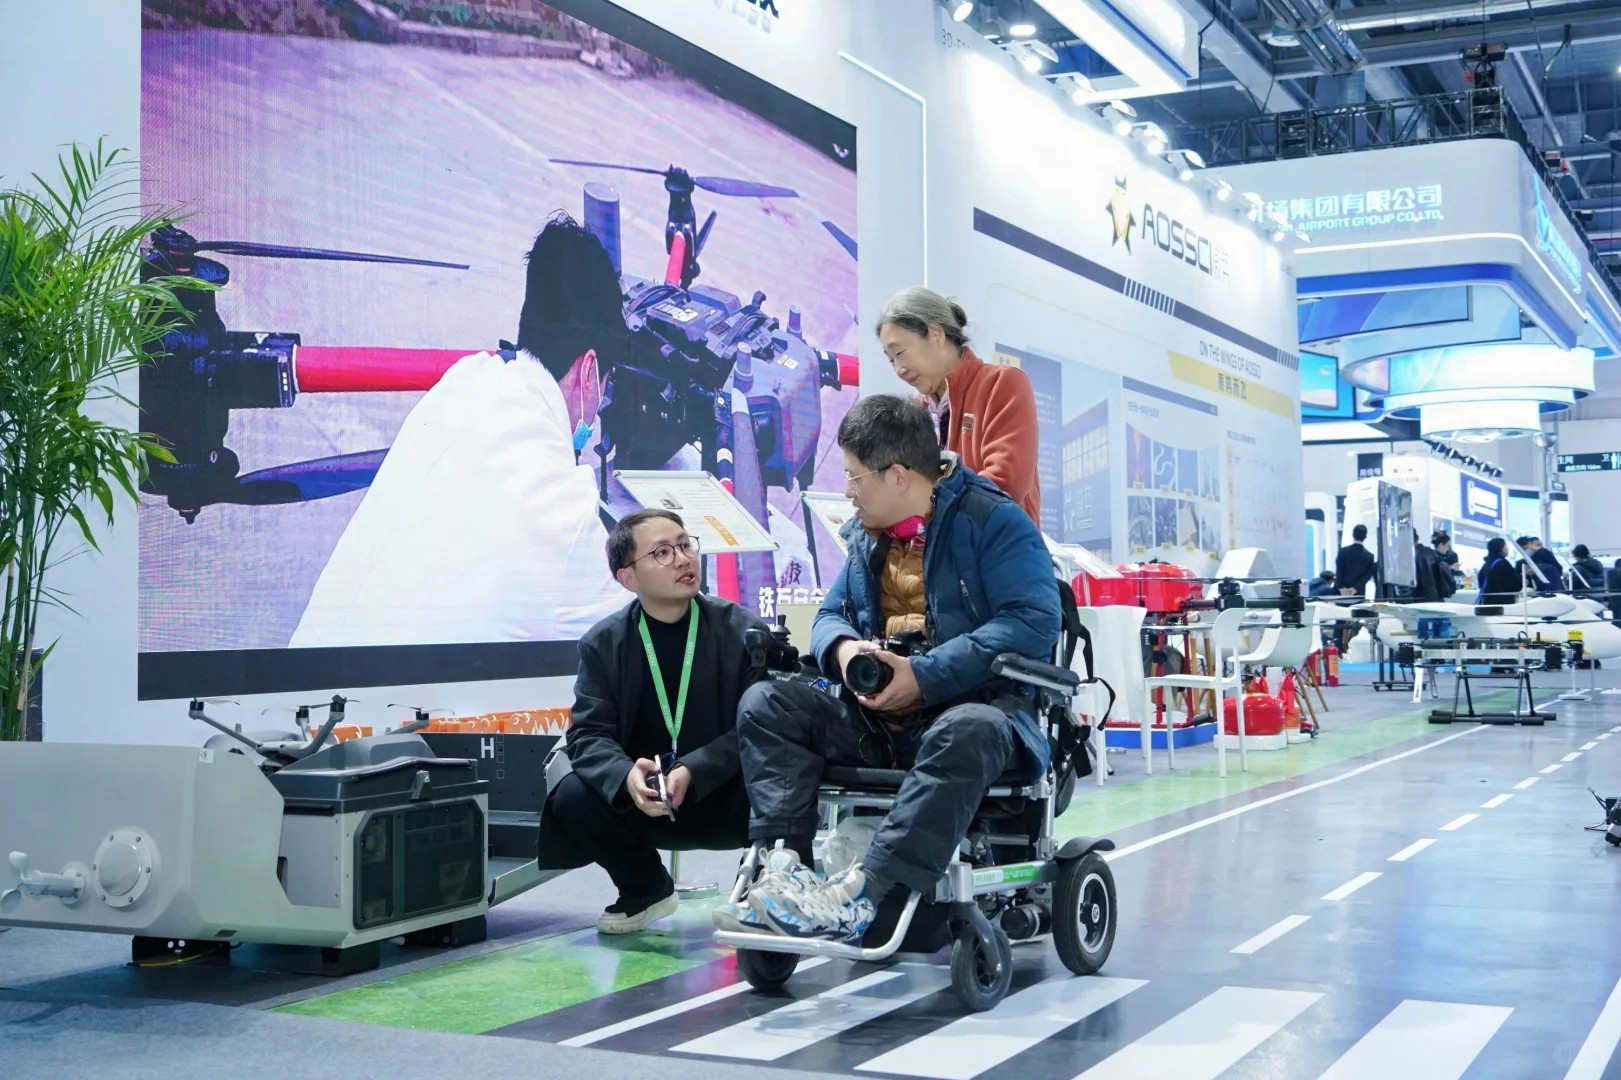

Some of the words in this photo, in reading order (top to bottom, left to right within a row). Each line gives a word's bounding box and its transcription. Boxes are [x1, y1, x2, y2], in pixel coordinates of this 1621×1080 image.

[1298, 217, 1350, 232] AIRPORT
[1352, 213, 1395, 227] GROUP
[1142, 203, 1212, 276] AOSSCI
[1199, 340, 1208, 357] ON
[1209, 343, 1219, 362] THE
[758, 586, 830, 618] 铁石安全
[480, 737, 495, 759] H
